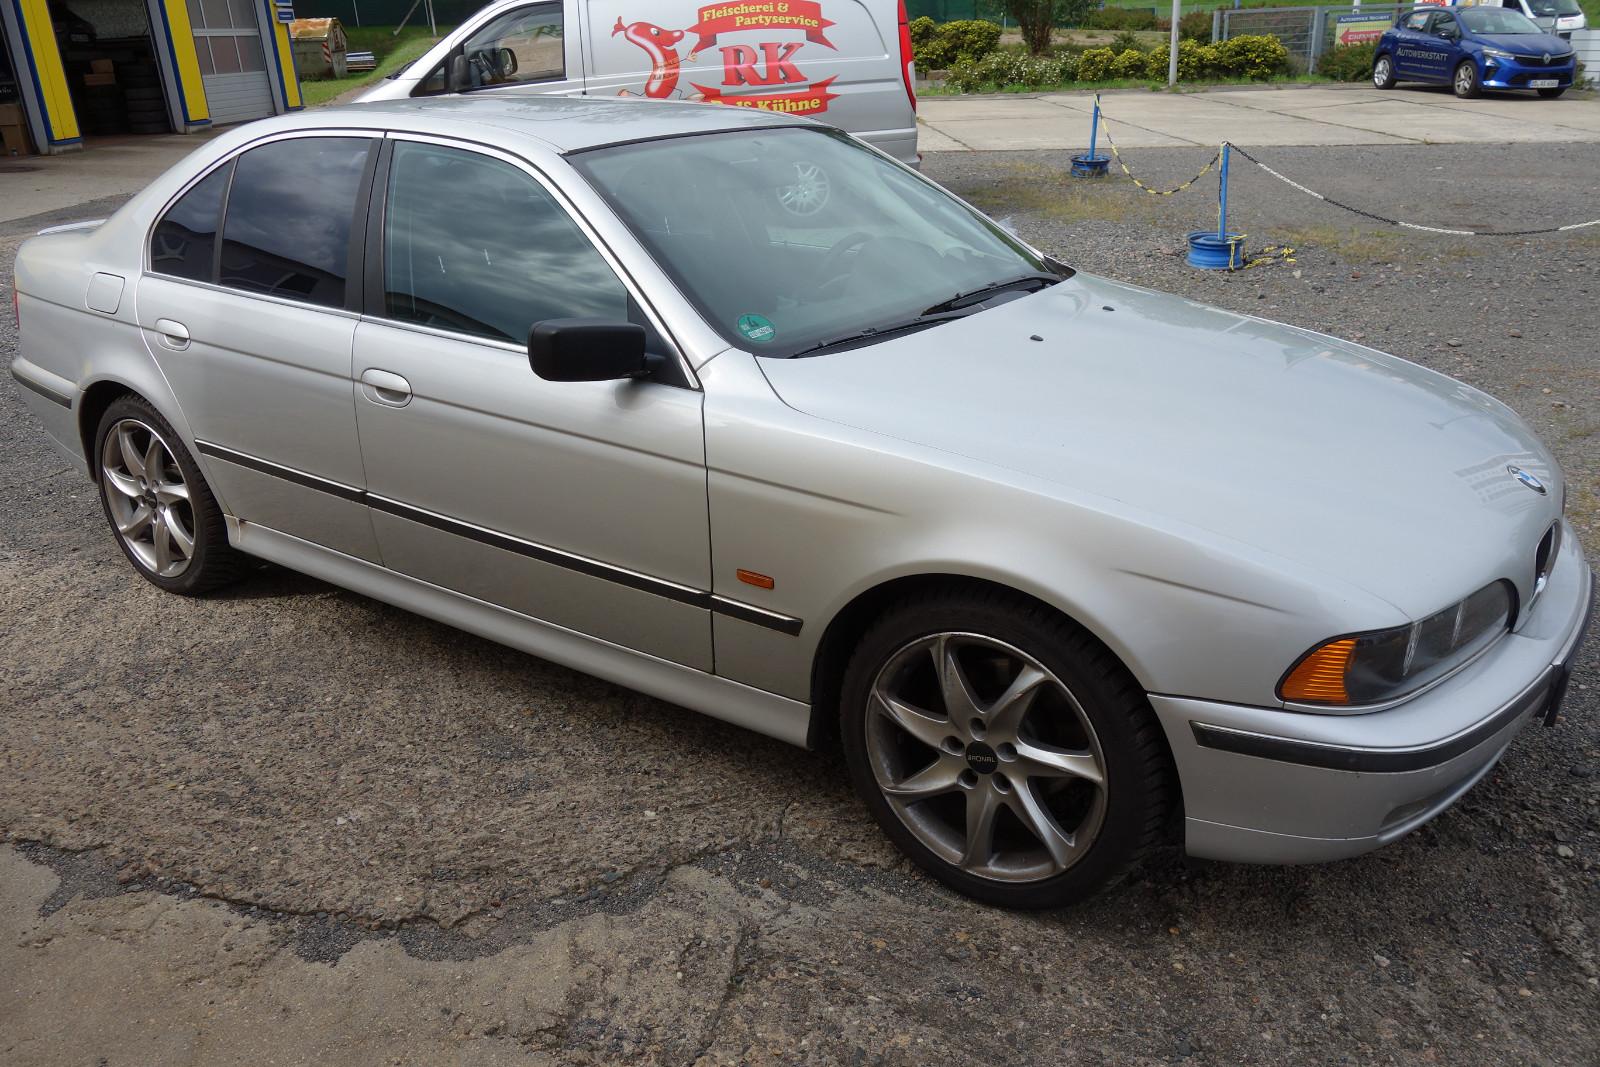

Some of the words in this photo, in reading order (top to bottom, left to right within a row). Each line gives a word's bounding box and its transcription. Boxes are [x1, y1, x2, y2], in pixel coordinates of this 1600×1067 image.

[703, 2, 774, 21] Fleischerei
[777, 2, 789, 13] &
[735, 13, 819, 28] Partyservice
[719, 42, 809, 86] RK
[757, 98, 821, 113] Kühne
